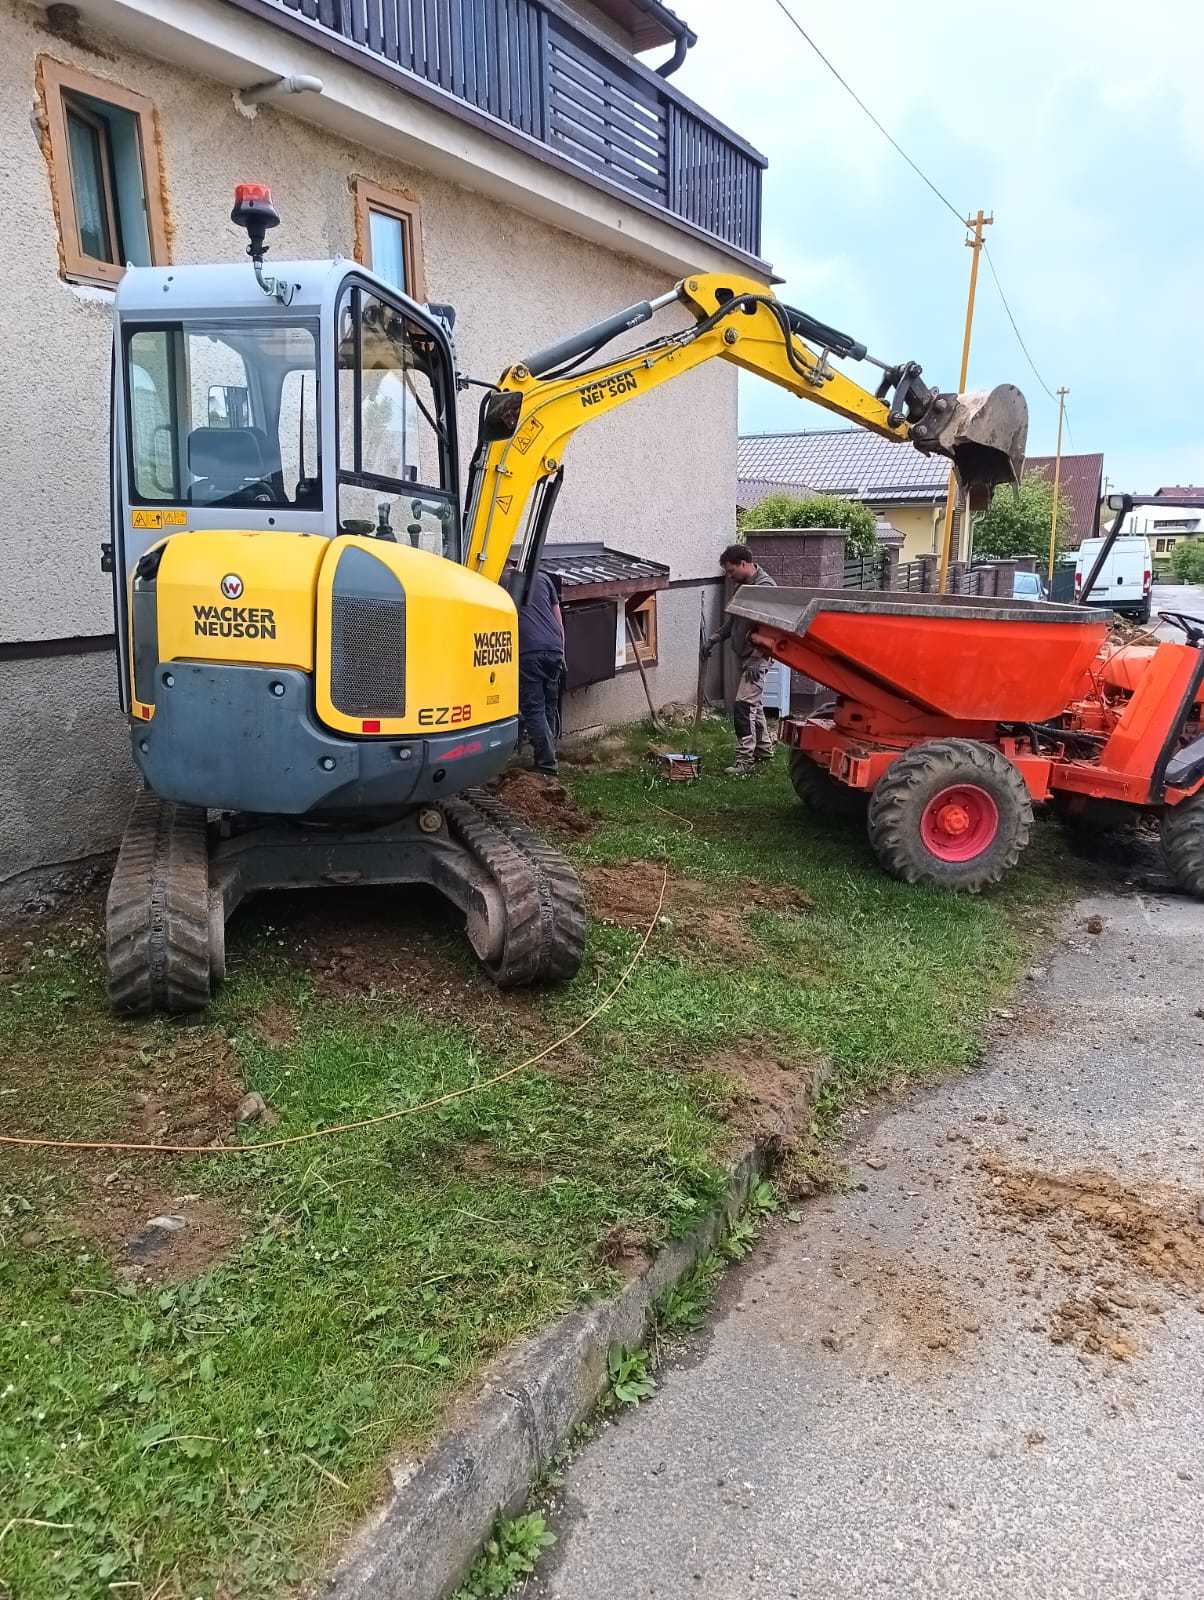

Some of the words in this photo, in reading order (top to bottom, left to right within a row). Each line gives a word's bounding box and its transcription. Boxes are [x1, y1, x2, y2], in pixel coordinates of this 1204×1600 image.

[223, 582, 240, 594] W
[192, 605, 276, 624] WACKER
[194, 620, 276, 640] NEUSON
[473, 630, 512, 650] WACKER
[473, 646, 512, 668] NEUSON
[418, 704, 472, 726] EZ28
